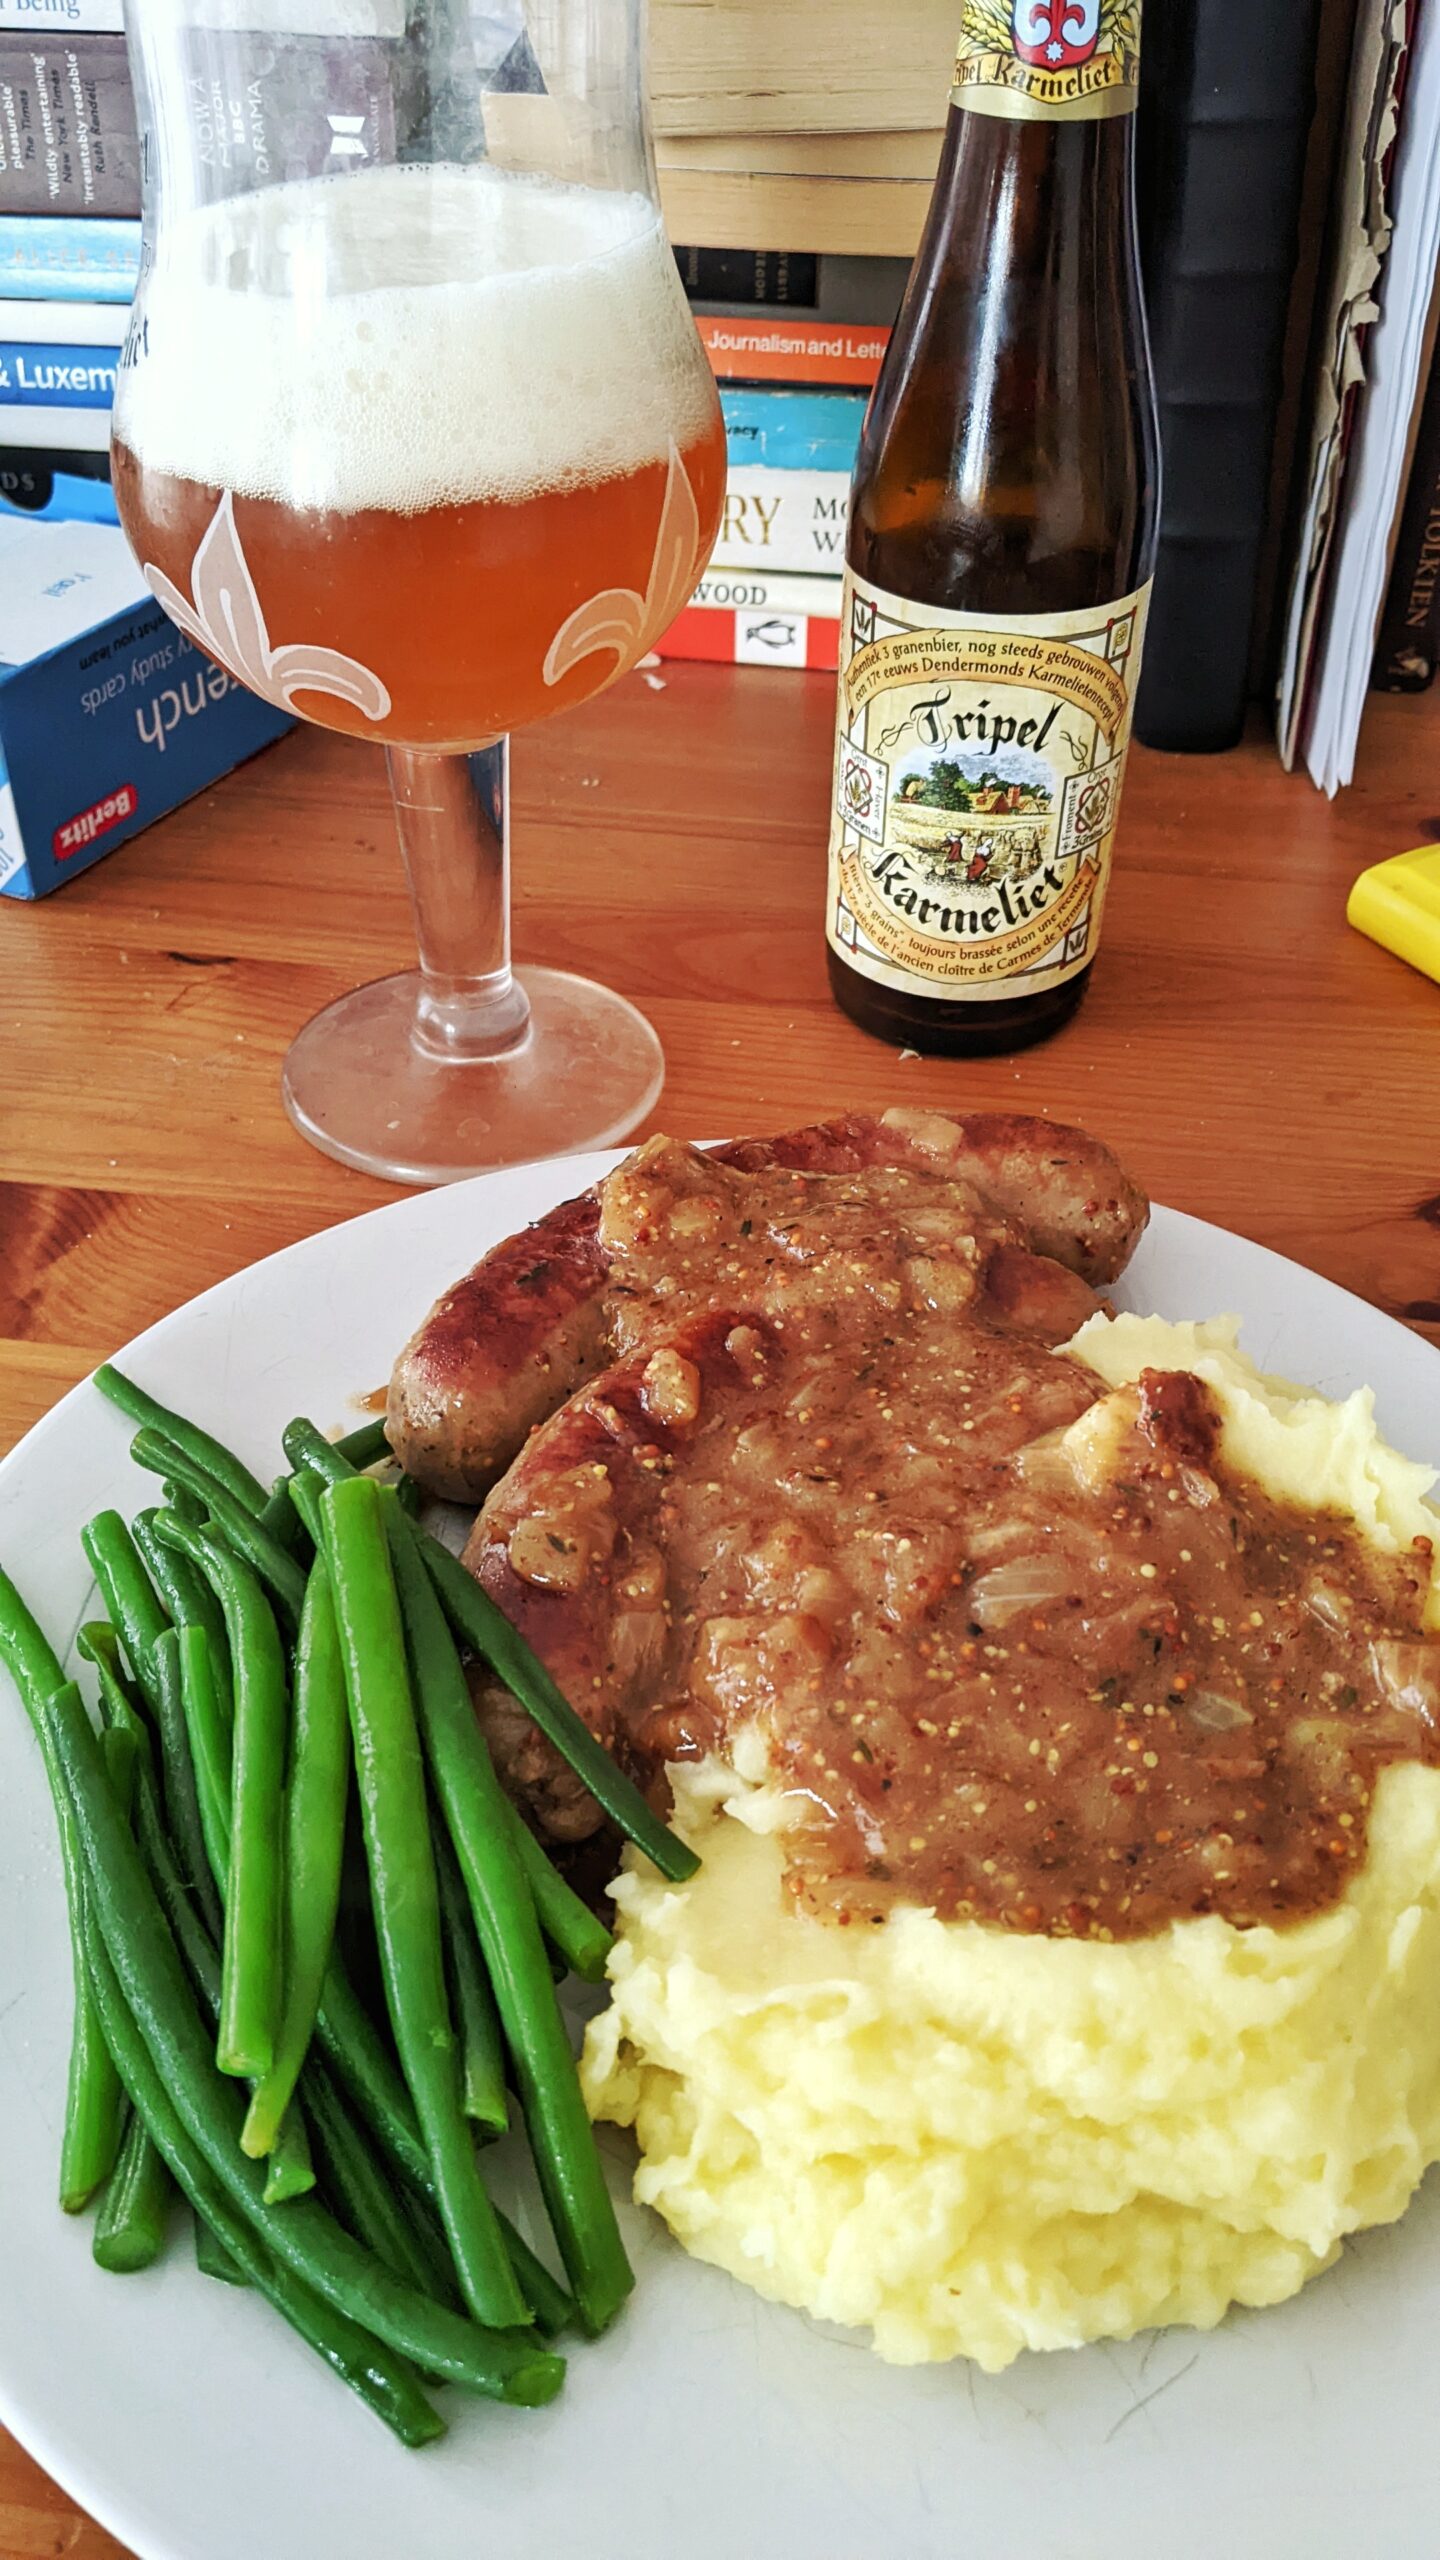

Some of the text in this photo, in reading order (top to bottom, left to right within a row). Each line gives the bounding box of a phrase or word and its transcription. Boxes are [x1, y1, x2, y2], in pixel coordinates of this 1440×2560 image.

[993, 54, 1112, 97] Karmeliet
[19, 89, 36, 160] The Times
[51, 69, 72, 184] New York Times
[85, 80, 105, 174] Ruth Rendell
[189, 77, 216, 166] NOW A
[228, 101, 246, 144] BBC
[248, 79, 270, 175] DRAMA
[708, 330, 805, 354] Journalism
[807, 337, 842, 357] and
[16, 356, 119, 391] Luxem
[79, 647, 111, 670] learn
[113, 626, 139, 655] you
[131, 644, 175, 686] study
[847, 648, 882, 686] Authentiek
[882, 645, 890, 659] 3
[892, 637, 962, 660] granenbier,
[968, 641, 996, 657] nog
[1001, 642, 1044, 659] steeds
[1045, 650, 1106, 683] gebrouwen
[81, 672, 126, 716] cards
[855, 685, 867, 701] een
[884, 660, 919, 679] eeuws
[921, 657, 1025, 677] Dendermonds
[1028, 664, 1115, 721] Karmelietenrecept
[909, 685, 1066, 756] Tripel
[60, 790, 131, 849] Berlitz
[1062, 795, 1077, 841] Froment
[868, 851, 1064, 935] Karmeliet
[908, 937, 957, 960] toujours
[959, 946, 1003, 961] brassée
[1007, 931, 1036, 952] selon
[1037, 913, 1058, 933] une
[1058, 878, 1083, 914] recette
[877, 933, 890, 949] de
[938, 962, 976, 977] cloître
[979, 962, 994, 975] de
[997, 944, 1042, 971] Carmes
[1043, 931, 1056, 947] de
[1056, 878, 1093, 932] Termonde
